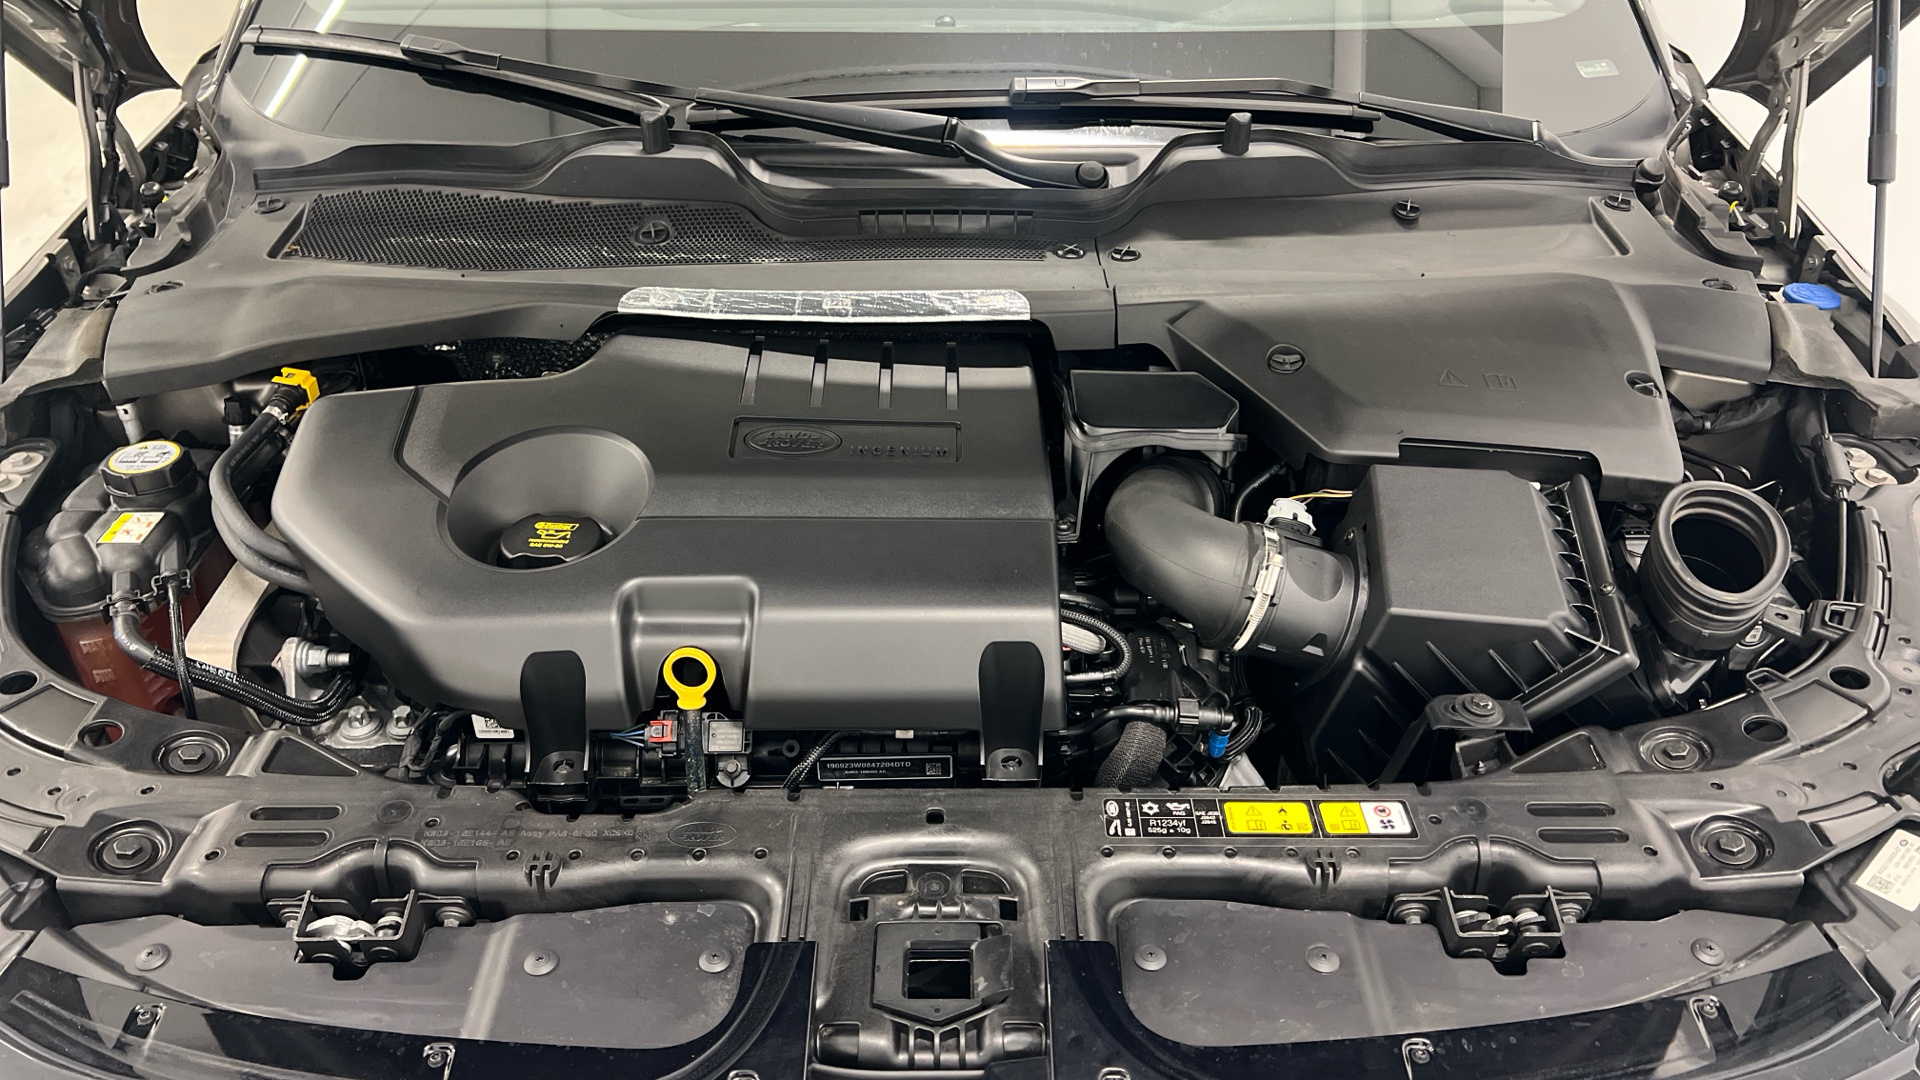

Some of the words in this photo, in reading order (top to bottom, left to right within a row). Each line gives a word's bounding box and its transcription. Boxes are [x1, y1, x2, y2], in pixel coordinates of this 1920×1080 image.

[759, 437, 824, 449] ROVER
[849, 445, 949, 457] INGENIUM
[1149, 819, 1186, 829] R1234yf
